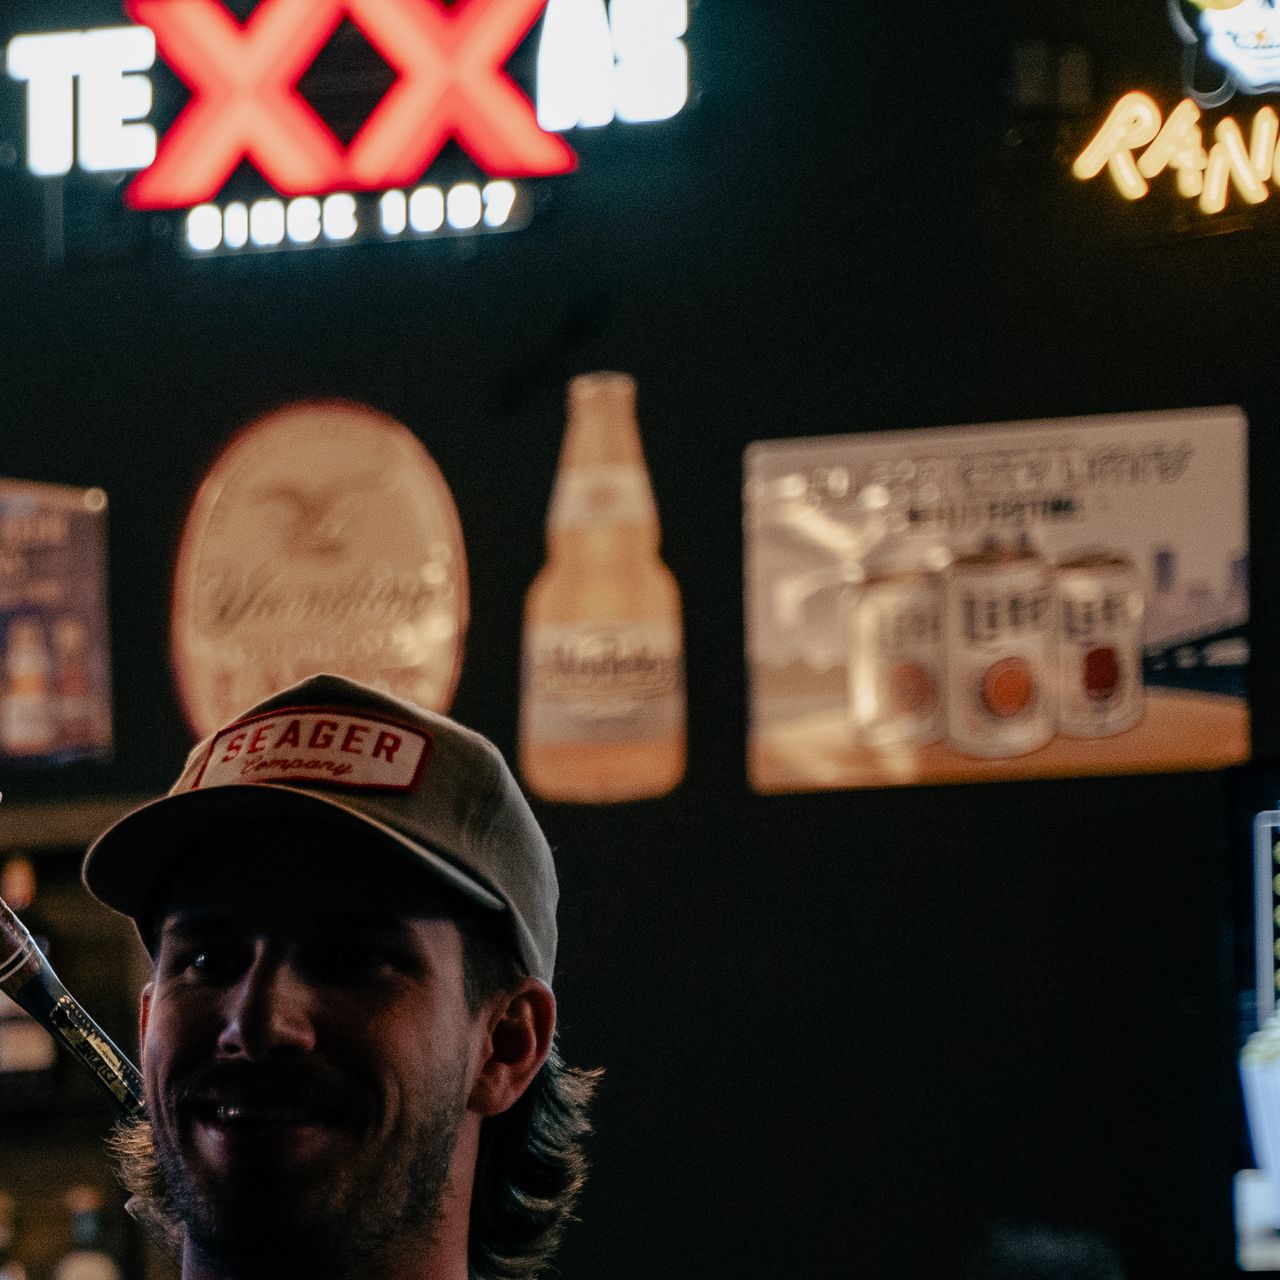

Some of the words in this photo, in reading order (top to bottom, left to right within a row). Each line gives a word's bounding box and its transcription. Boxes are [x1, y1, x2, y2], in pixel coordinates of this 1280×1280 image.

[1072, 90, 1280, 214] RAN
[220, 719, 403, 764] SEAGER
[239, 754, 354, 777] Company
